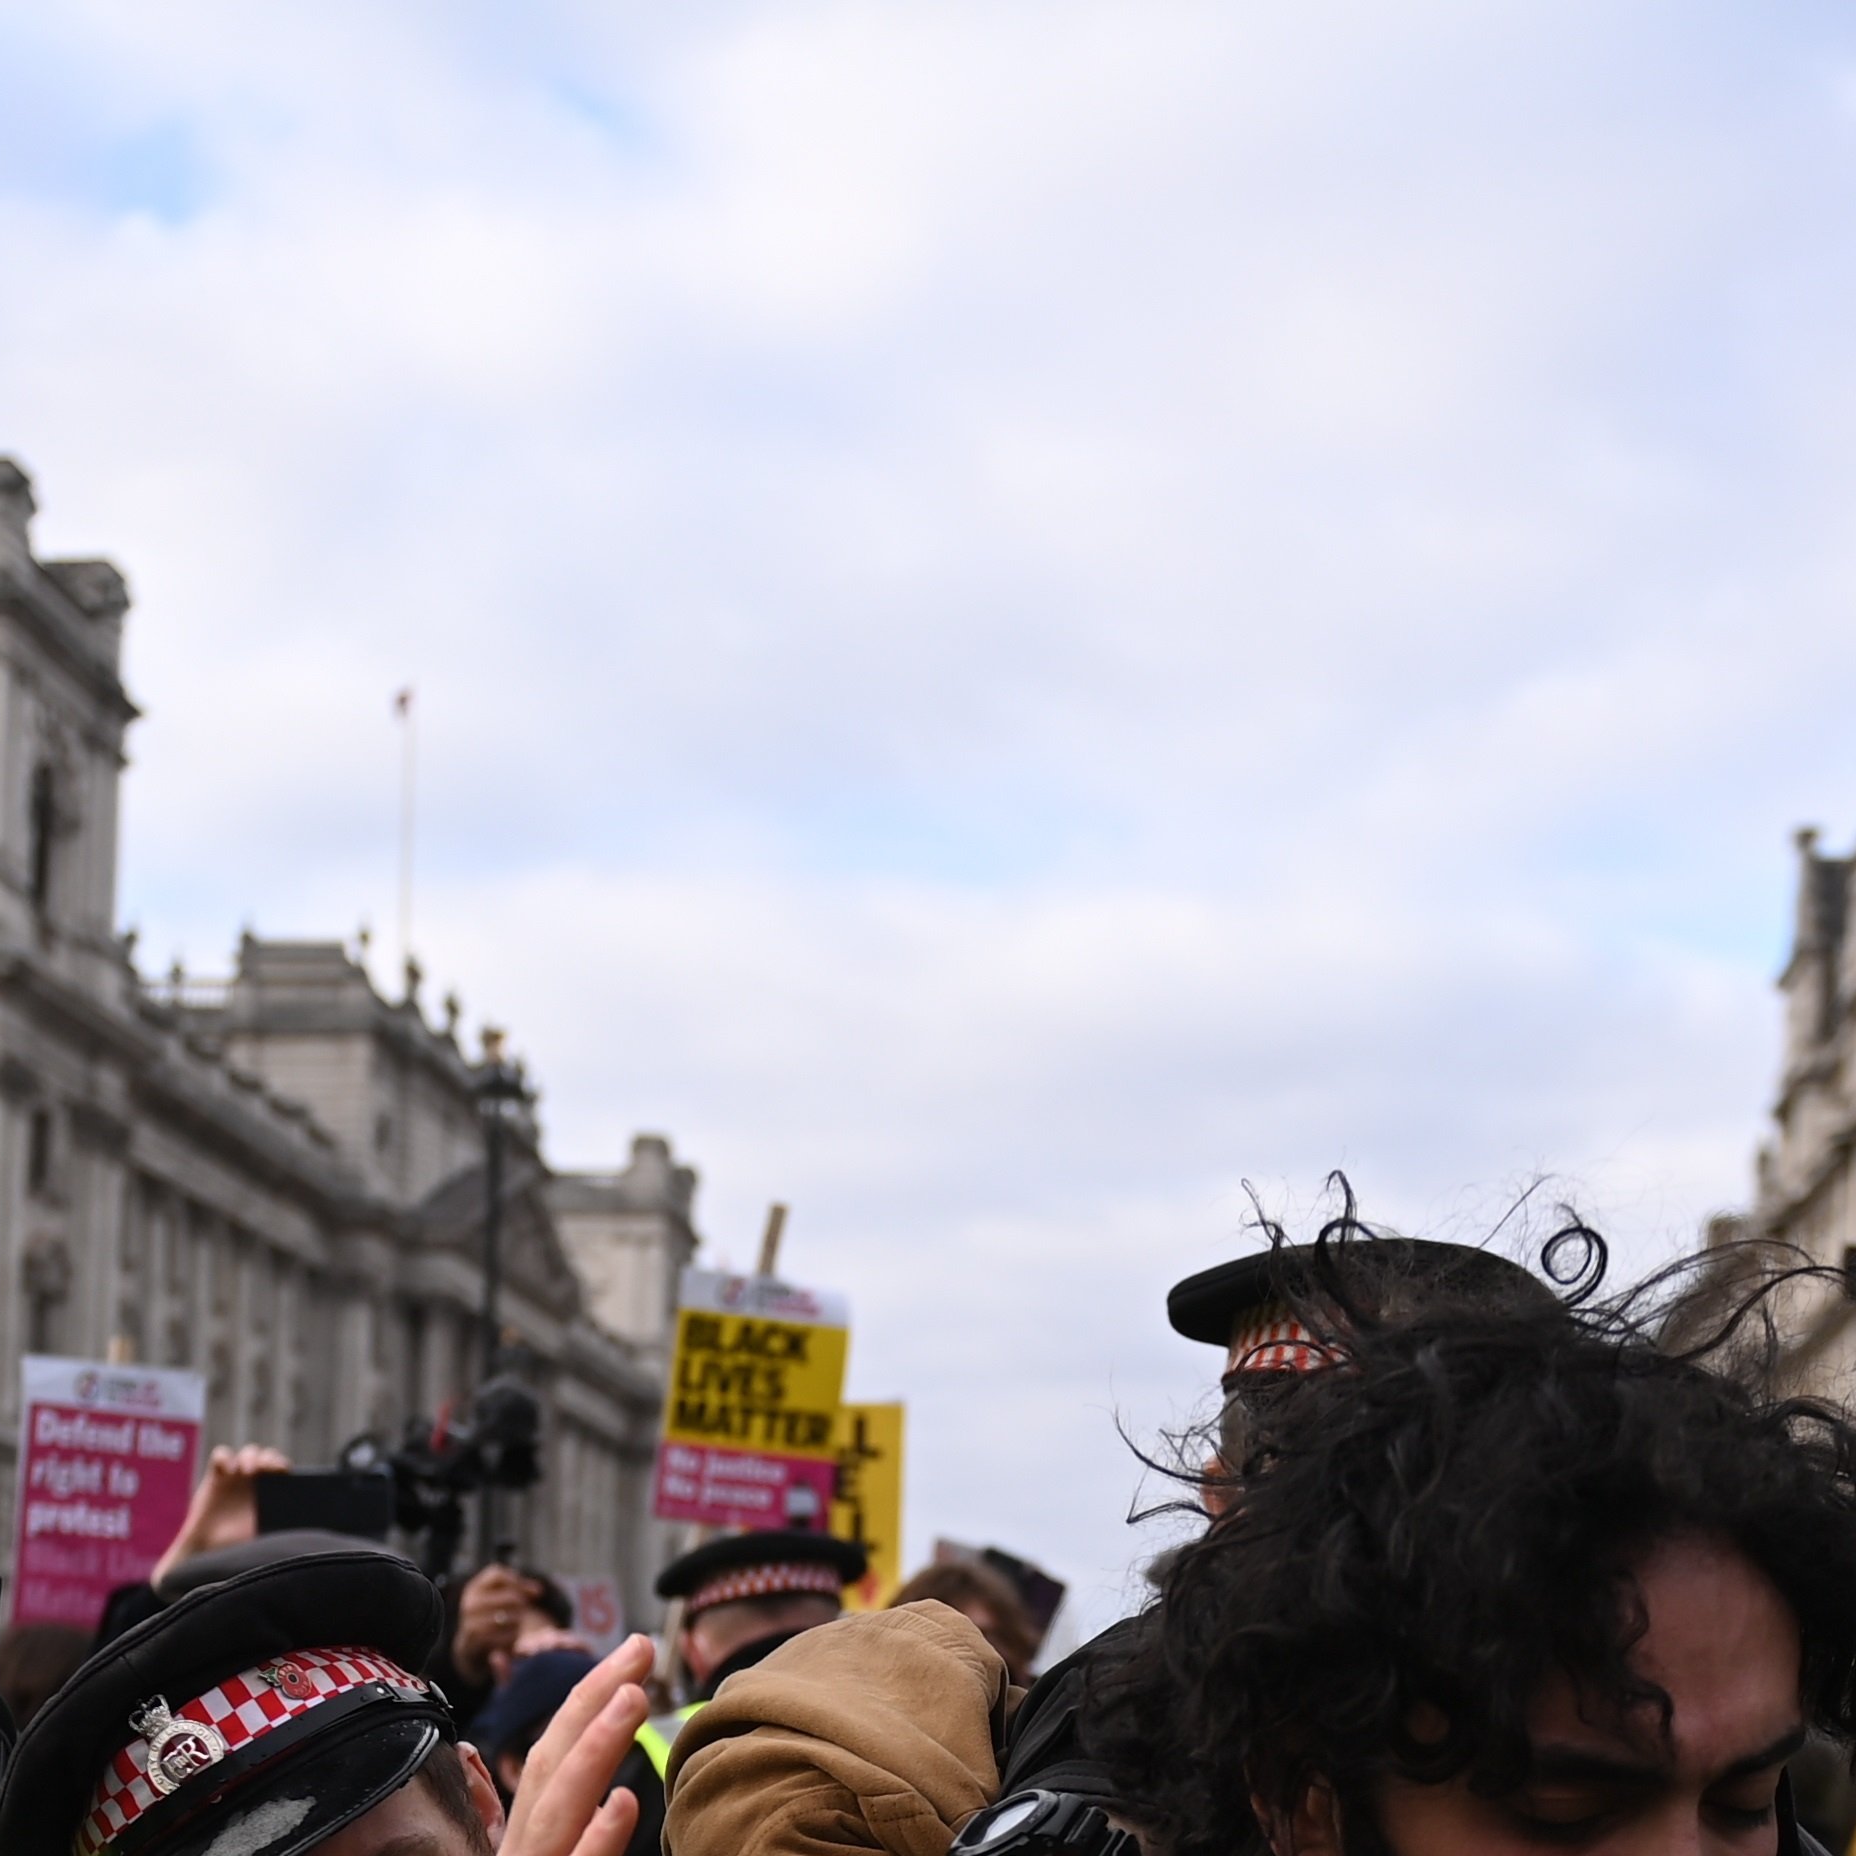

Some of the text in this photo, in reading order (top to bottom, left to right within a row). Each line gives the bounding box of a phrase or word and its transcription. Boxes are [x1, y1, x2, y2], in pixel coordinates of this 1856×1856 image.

[685, 1314, 809, 1363] BLACK
[679, 1357, 785, 1404] LIVES
[36, 1408, 185, 1461] Defend the
[674, 1399, 833, 1448] MATTER
[30, 1452, 139, 1499] right to
[666, 1447, 787, 1484] No justice
[663, 1473, 773, 1510] No peace
[25, 1503, 131, 1540] protest
